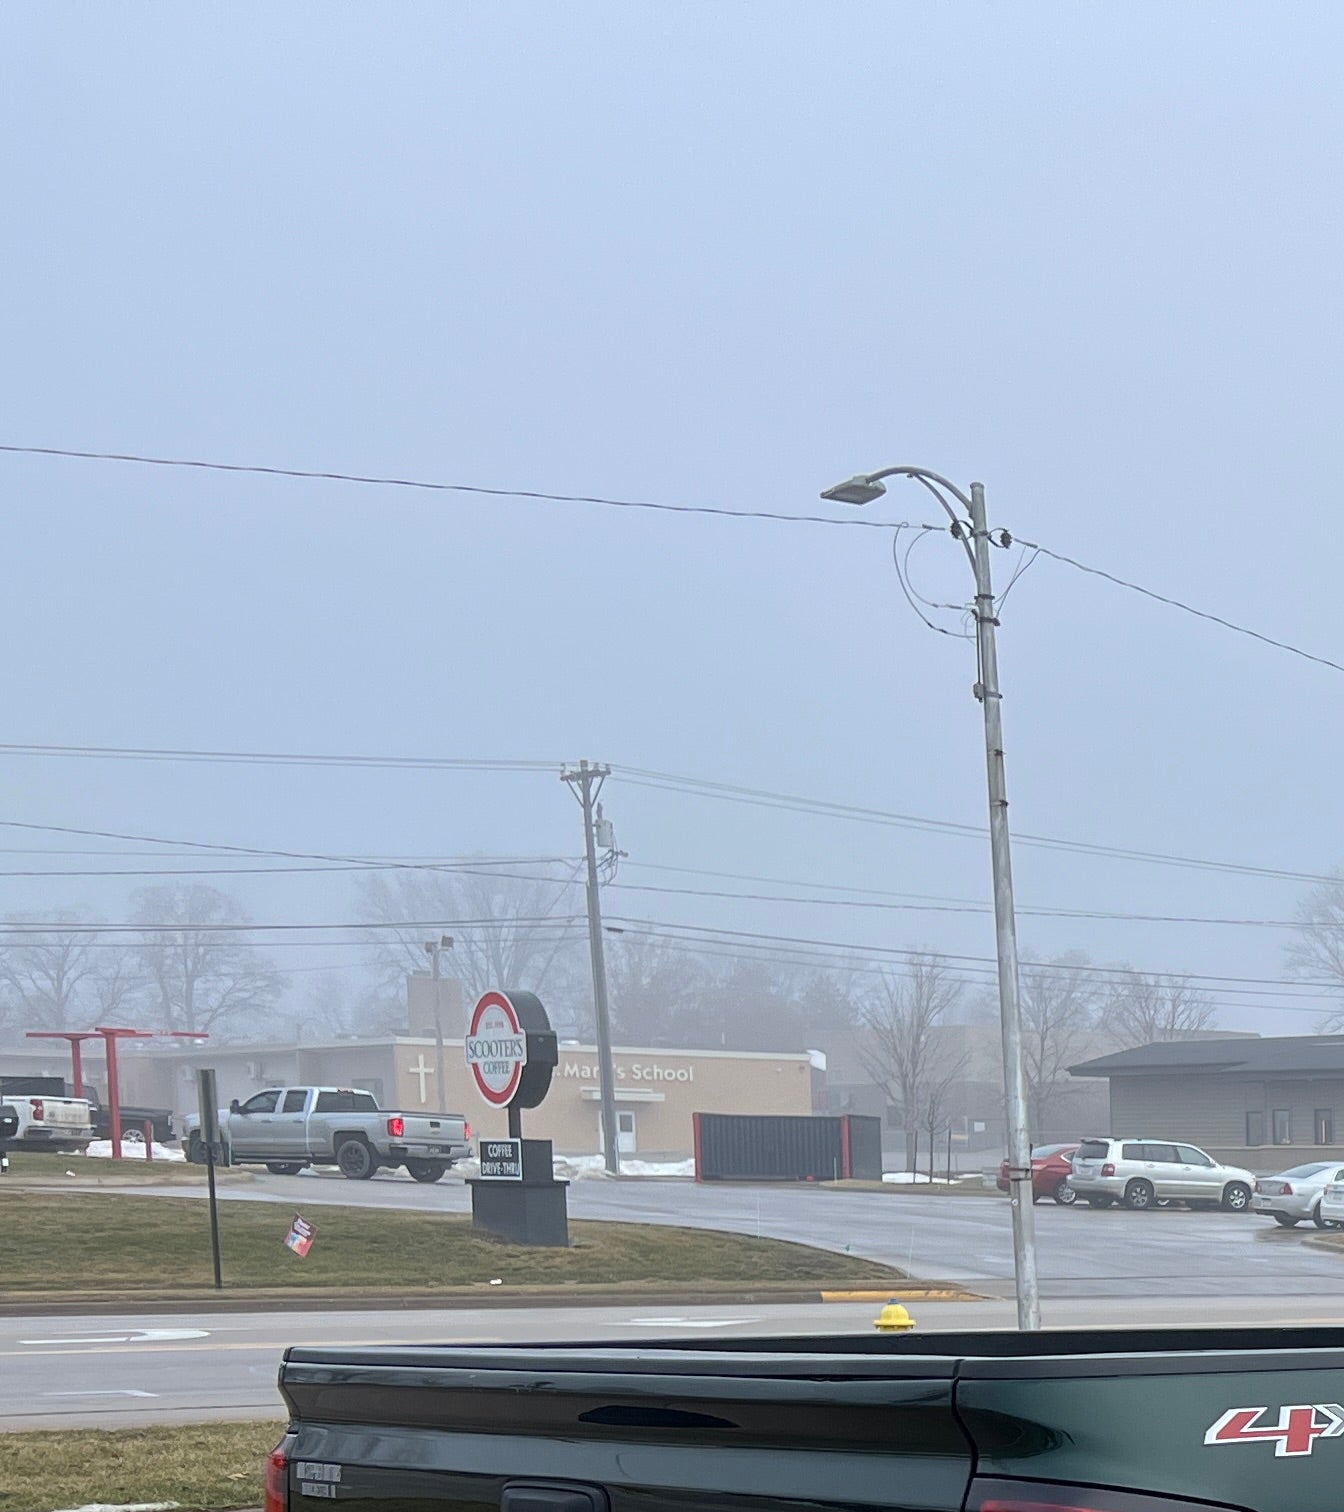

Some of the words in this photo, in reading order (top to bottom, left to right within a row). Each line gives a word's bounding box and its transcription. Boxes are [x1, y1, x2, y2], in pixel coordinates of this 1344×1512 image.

[469, 1038, 524, 1059] SCOOTER'S
[483, 1061, 510, 1075] COFFEE
[564, 1063, 626, 1080] Mar's
[632, 1063, 694, 1081] School
[487, 1143, 513, 1158] COFFEE
[481, 1161, 520, 1176] DRIVE-THRU
